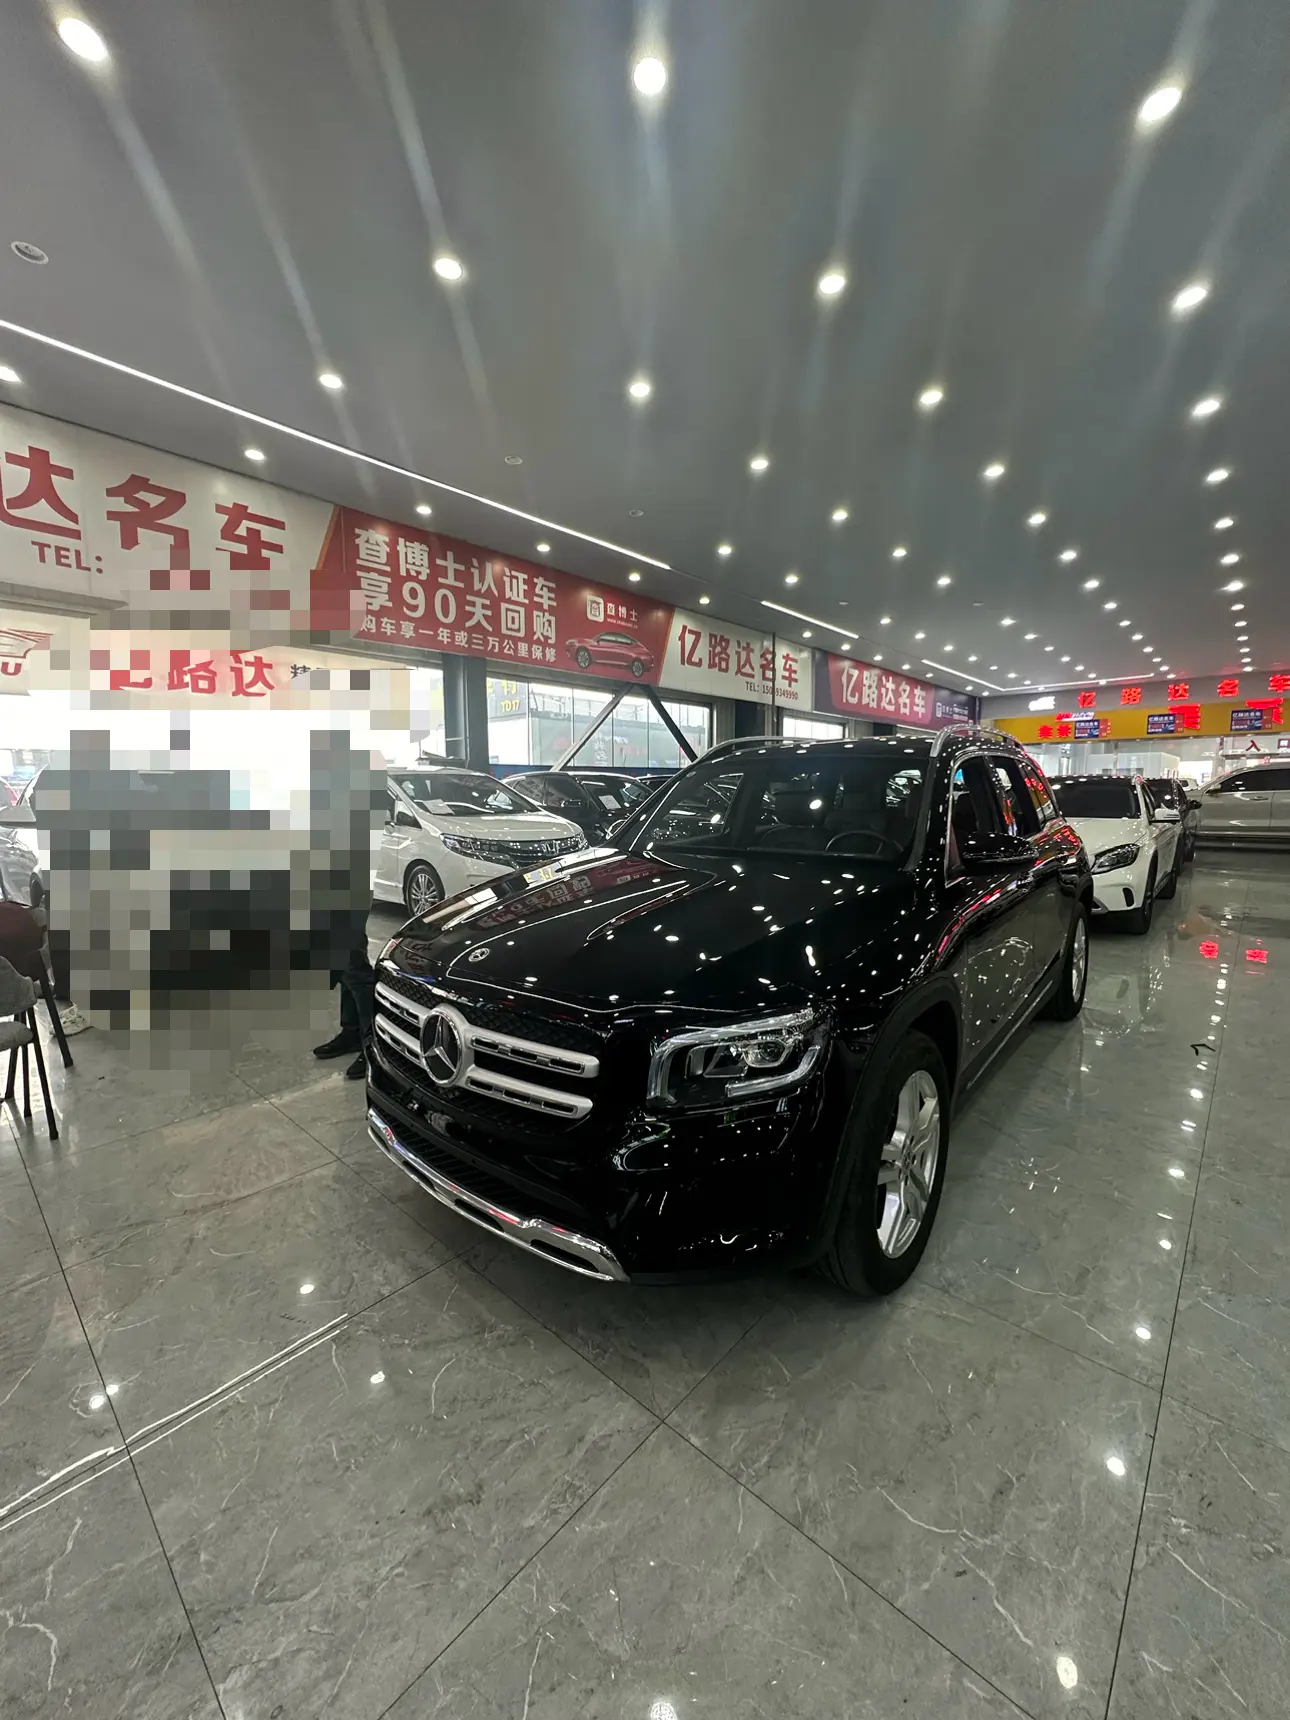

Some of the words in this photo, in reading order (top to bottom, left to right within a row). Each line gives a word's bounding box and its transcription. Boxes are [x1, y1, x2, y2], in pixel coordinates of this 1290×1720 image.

[31, 540, 104, 575] TEL:
[354, 527, 558, 611] 查博士认证车
[358, 569, 557, 645] 享90天回购
[678, 624, 799, 687] 亿路达名车
[762, 684, 799, 701] 1509349990
[841, 663, 926, 718] 亿路达名车
[1078, 673, 1290, 708] 亿路达名车
